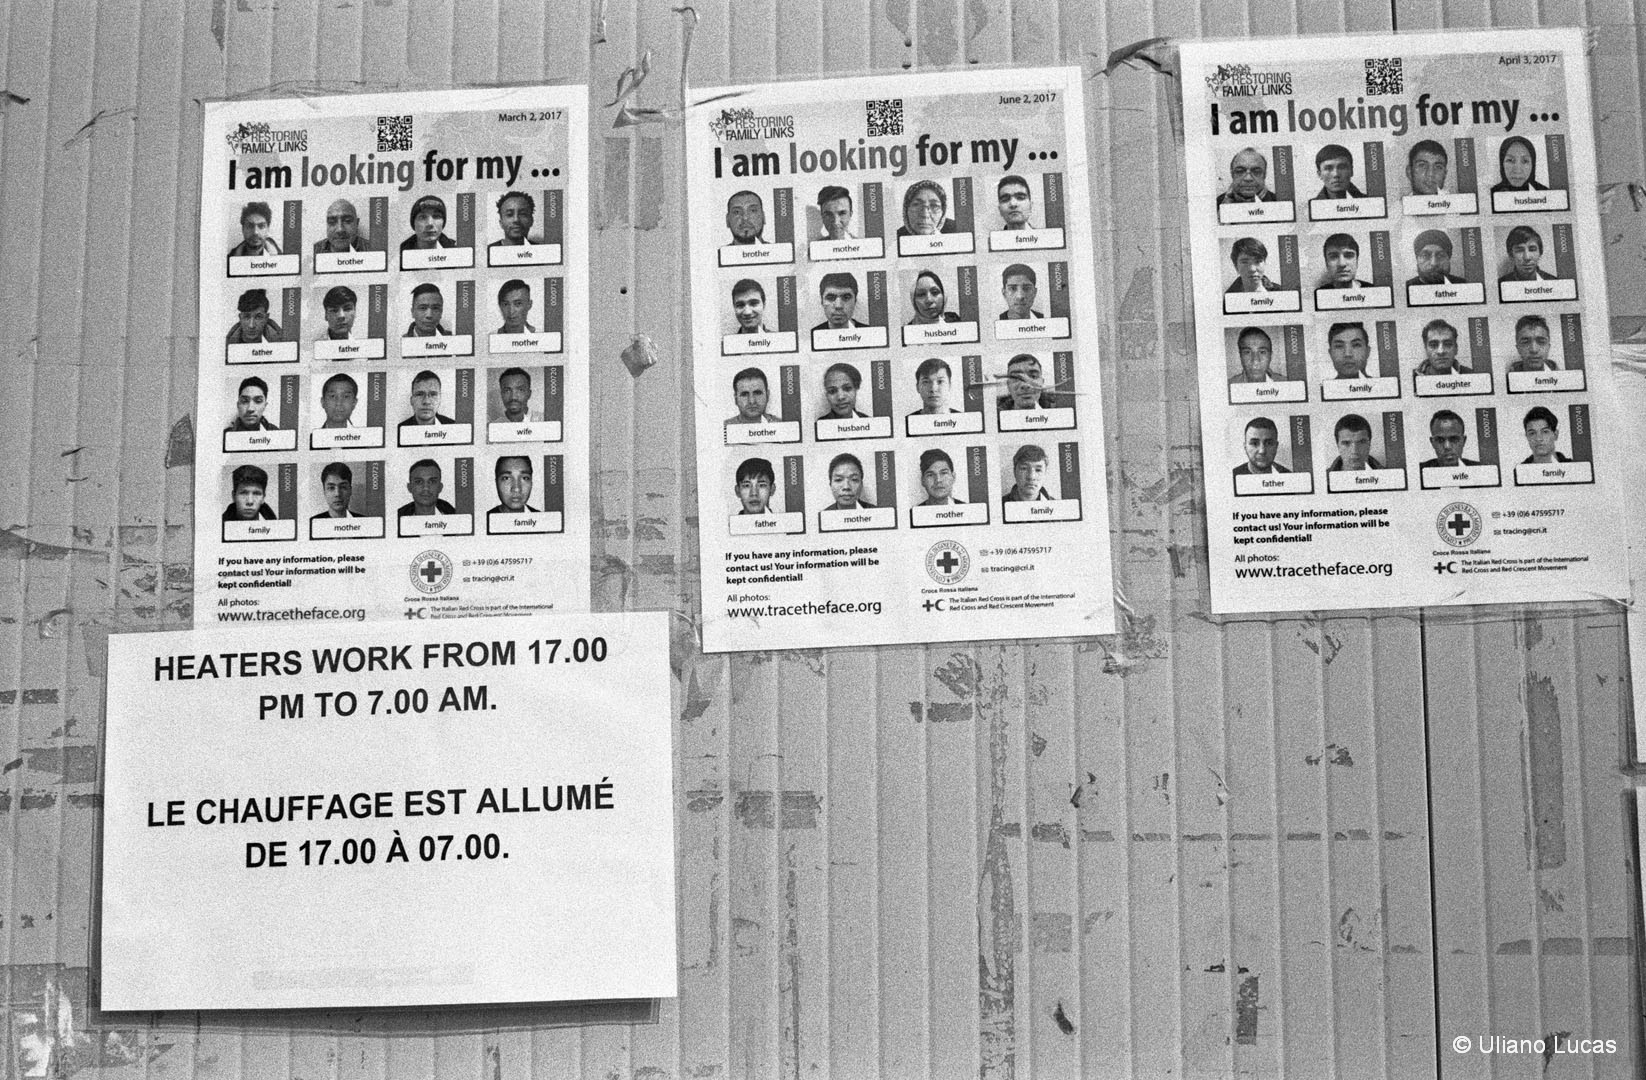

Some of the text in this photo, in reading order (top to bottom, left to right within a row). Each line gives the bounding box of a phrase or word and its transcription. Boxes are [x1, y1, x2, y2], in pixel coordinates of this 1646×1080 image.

[1499, 54, 1557, 66] April 3, 2017
[1231, 71, 1291, 85] RESTORING
[1222, 82, 1292, 97] FAMILY LINKS
[999, 93, 1056, 104] June 2, 2017
[499, 111, 562, 121] March 2, 2017
[1211, 104, 1219, 135] I
[1230, 110, 1278, 134] am
[1288, 97, 1408, 136] looking
[1416, 93, 1463, 126] for
[1472, 100, 1519, 132] my
[734, 115, 793, 130] RESTORING
[250, 129, 307, 143] RESTORING
[726, 126, 794, 140] FAMILY LINKS
[241, 140, 307, 153] FAMILY LINKS
[715, 148, 722, 178] I
[733, 153, 779, 177] am
[790, 138, 907, 177] looking
[916, 134, 962, 166] for
[971, 138, 1018, 171] my
[229, 160, 236, 189] I
[246, 166, 291, 189] am
[302, 153, 414, 192] looking
[423, 150, 468, 181] for
[477, 156, 522, 187] my
[1015, 235, 1038, 243] family
[742, 250, 769, 258] brother
[1251, 298, 1273, 306] family
[1342, 294, 1365, 302] family
[924, 329, 957, 337] husband
[839, 334, 861, 342] family
[425, 342, 447, 350] family
[748, 339, 770, 347] family
[1436, 381, 1470, 390] daughter
[1535, 377, 1558, 385] family
[1256, 388, 1279, 396] family
[1349, 384, 1372, 392] family
[1025, 415, 1048, 423] family
[838, 424, 870, 432] husband
[934, 420, 956, 428] family
[425, 431, 446, 439] family
[249, 437, 270, 445] family
[1542, 469, 1565, 477] family
[1301, 509, 1357, 517] information,
[1359, 508, 1388, 517] please
[425, 521, 447, 529] family
[514, 519, 536, 527] family
[1305, 521, 1358, 529] information
[1234, 534, 1312, 545] kept confidential!
[793, 549, 847, 557] information,
[849, 547, 877, 556] please
[1247, 554, 1279, 563] photos:
[796, 560, 849, 569] information
[851, 558, 866, 566] will
[990, 565, 1034, 573] tracing@cri.it
[1235, 562, 1392, 578] www.tracetheface.org
[230, 599, 258, 607] photos:
[739, 594, 769, 603] photos:
[727, 600, 881, 618] www.tracetheface.org
[218, 607, 365, 621] www.tracetheface.org
[155, 637, 607, 681] HEATERS WORK FROM 17.00
[260, 686, 496, 720] PM TO 7.00 AM.
[148, 777, 614, 827] LE CHAUFFAGE EST ALLUMÉ
[246, 830, 508, 868] DE 17.00 À 07.00.
